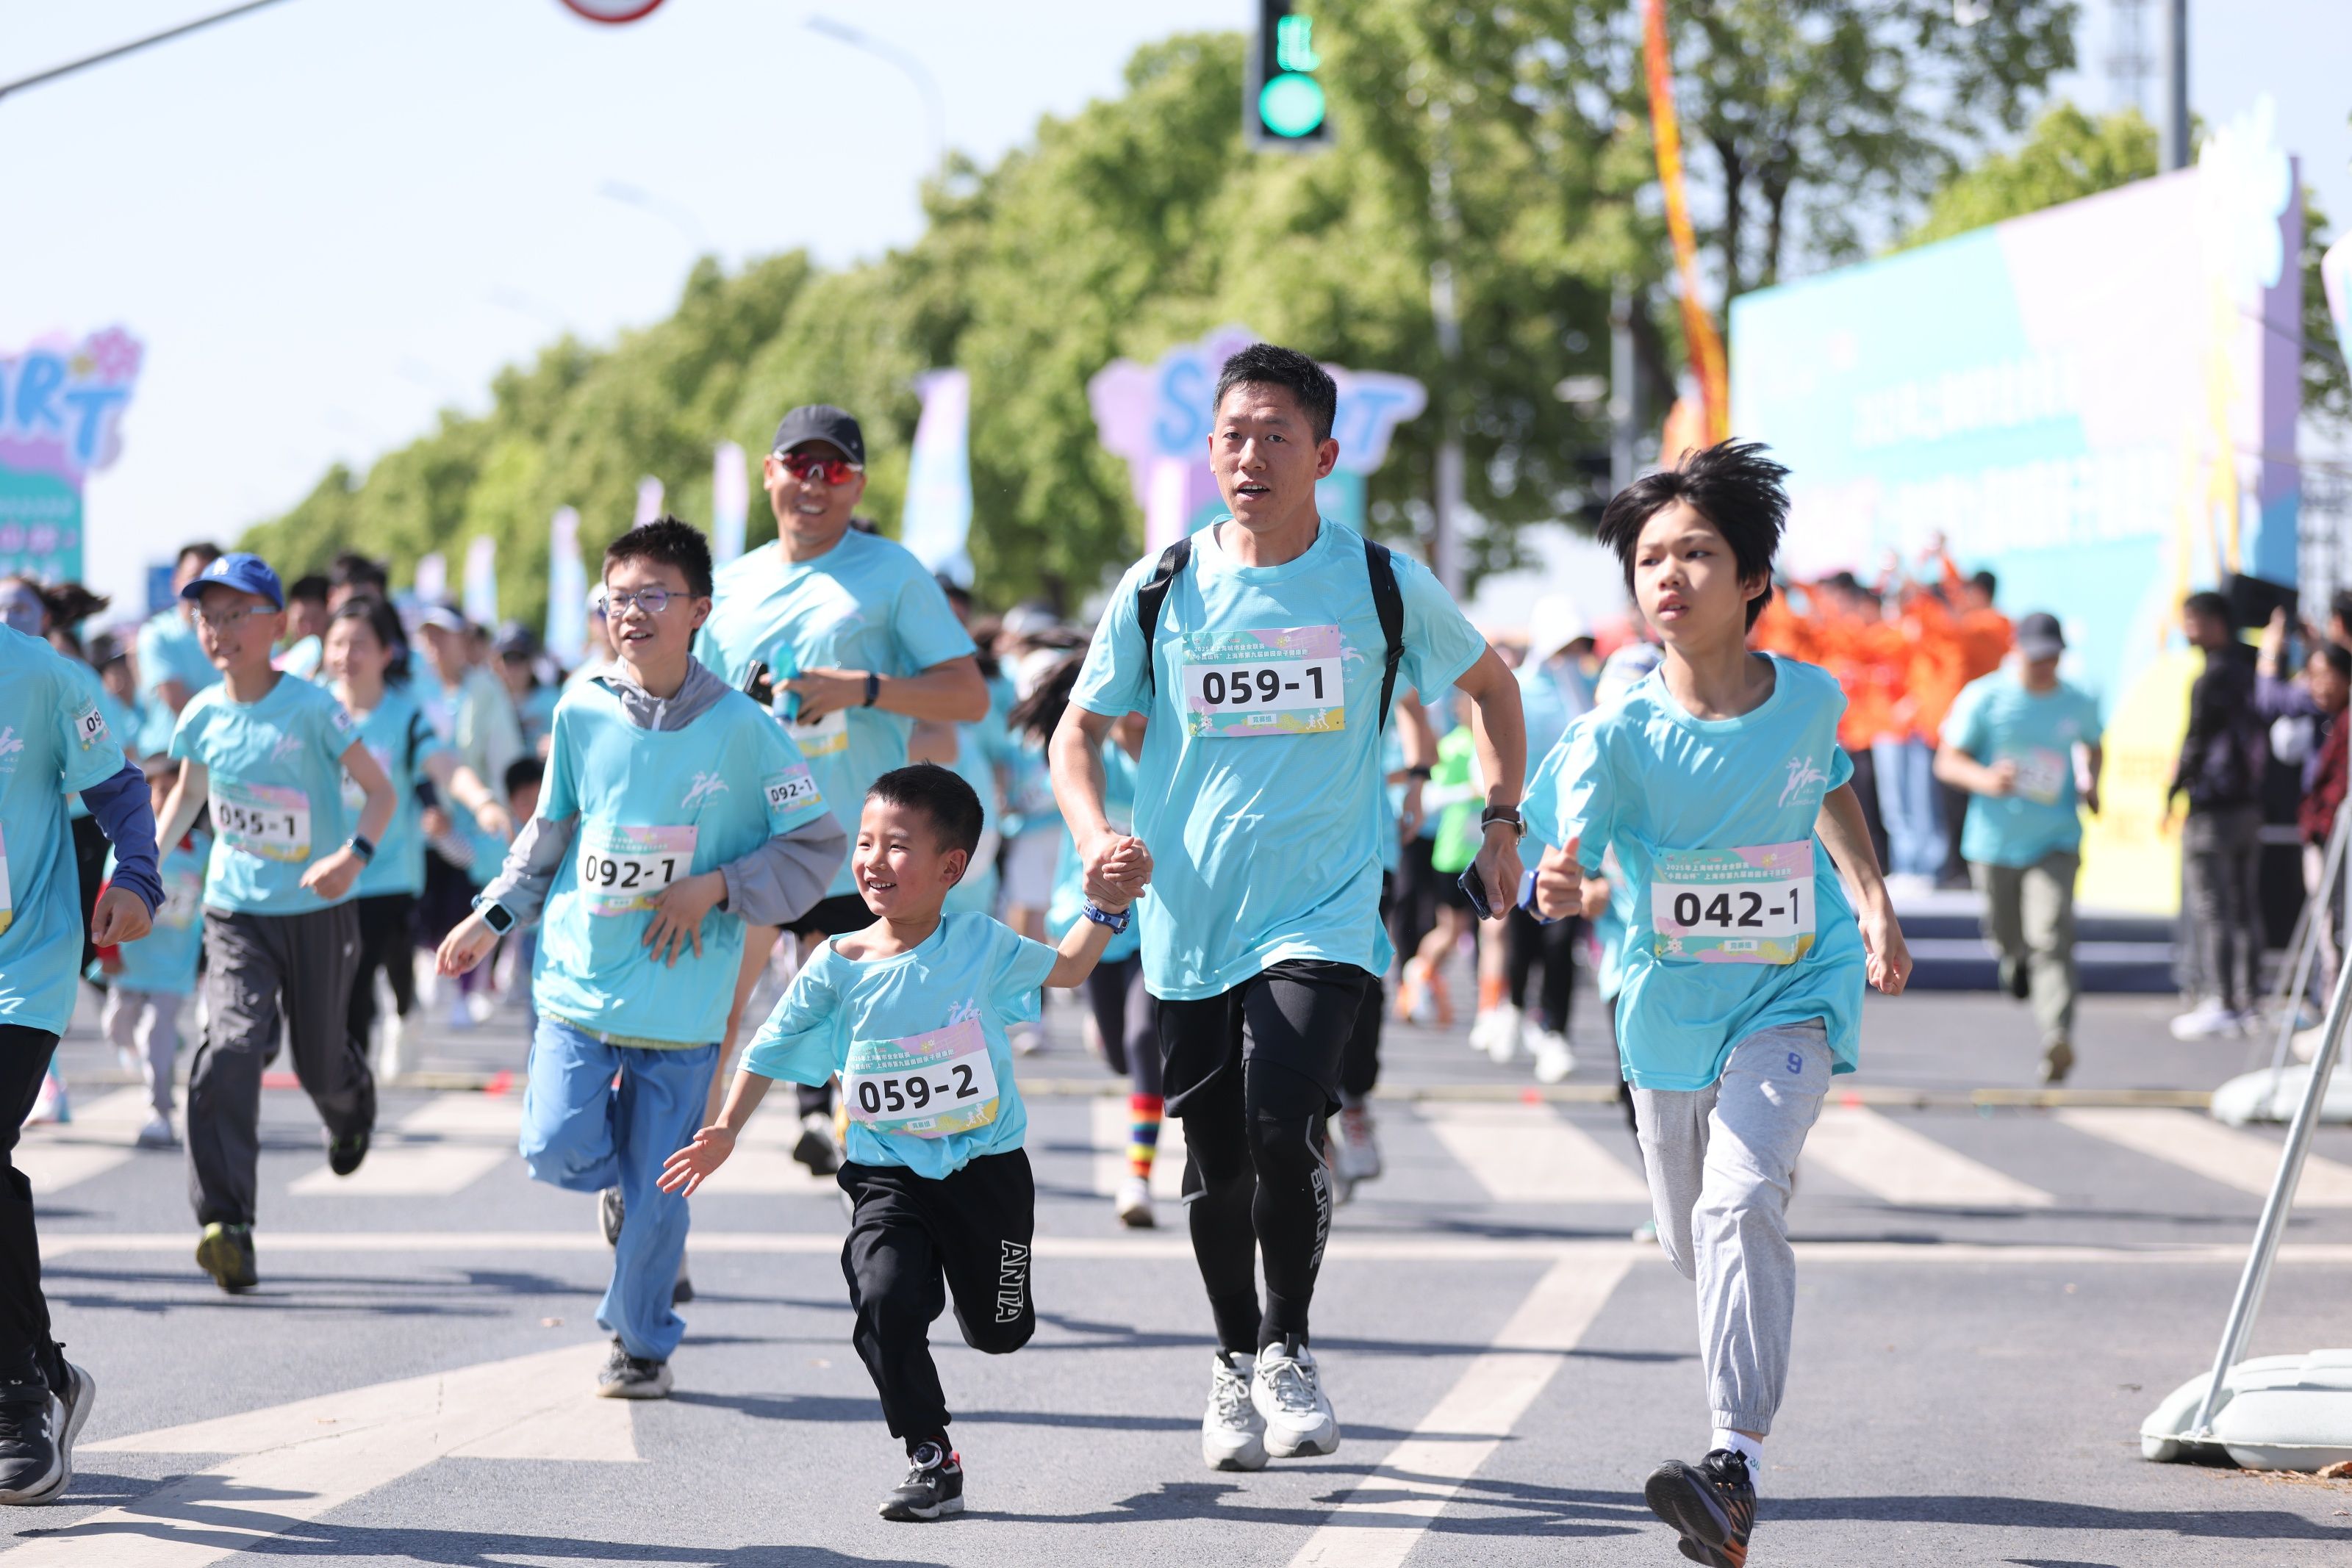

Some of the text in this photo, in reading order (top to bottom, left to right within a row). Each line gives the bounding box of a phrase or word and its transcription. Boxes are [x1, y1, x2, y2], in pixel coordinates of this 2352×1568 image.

[0, 350, 126, 460] RT
[1203, 666, 1324, 705] 059-1
[771, 778, 812, 802] 092-1
[220, 804, 295, 838] 055-1
[586, 855, 675, 888] 092-1
[1674, 888, 1798, 927] 042-1
[1786, 1052, 1802, 1074] 9
[858, 1064, 979, 1114] 059-2
[995, 1240, 1028, 1323] ANTA
